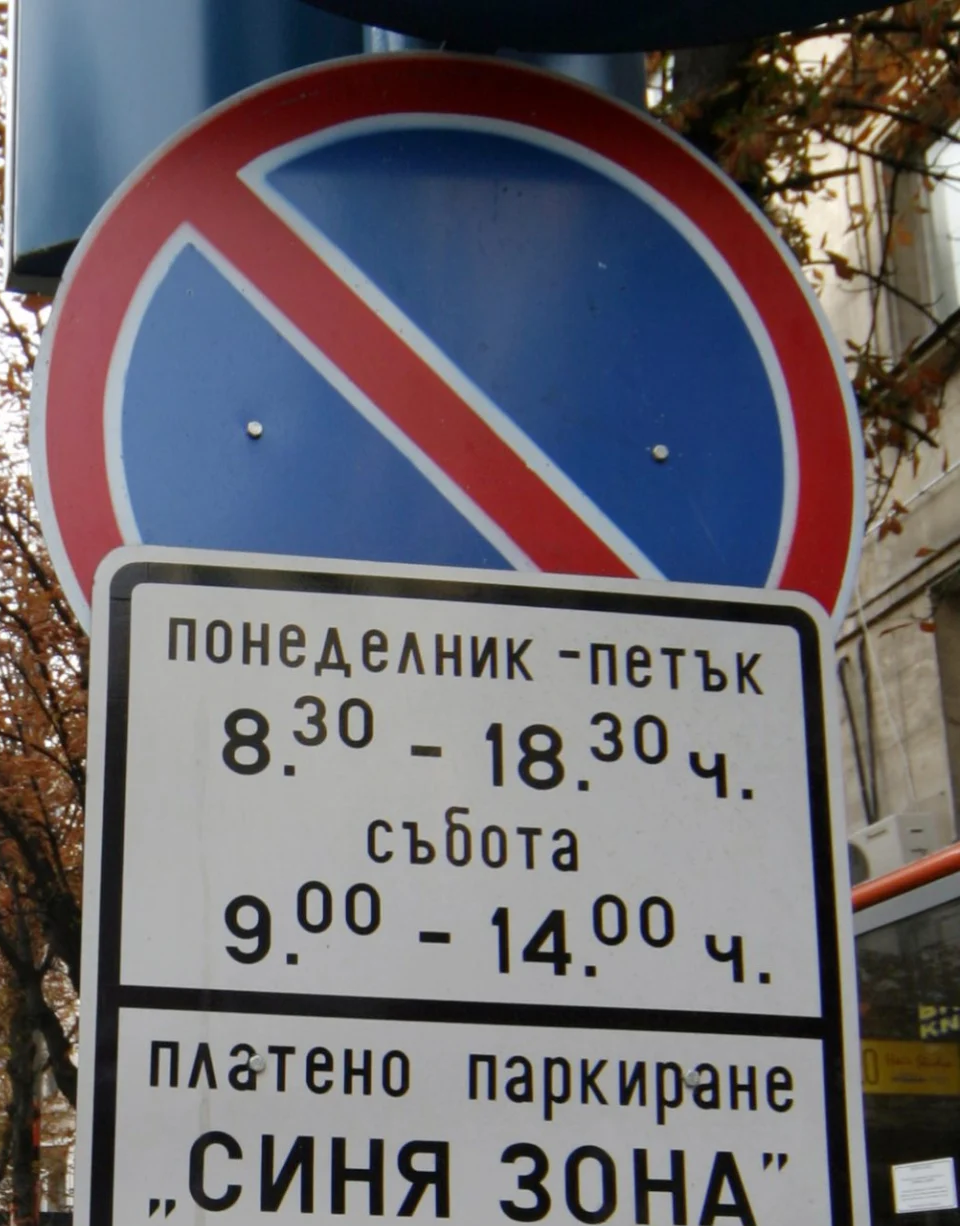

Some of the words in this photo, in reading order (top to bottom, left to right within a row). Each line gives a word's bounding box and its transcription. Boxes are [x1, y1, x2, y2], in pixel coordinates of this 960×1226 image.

[168, 617, 534, 682] понеделник
[688, 751, 753, 800] ч.
[367, 806, 579, 873] събота
[705, 934, 771, 985] ч.
[149, 1040, 410, 1098] платено
[468, 1053, 794, 1126] паркиране
